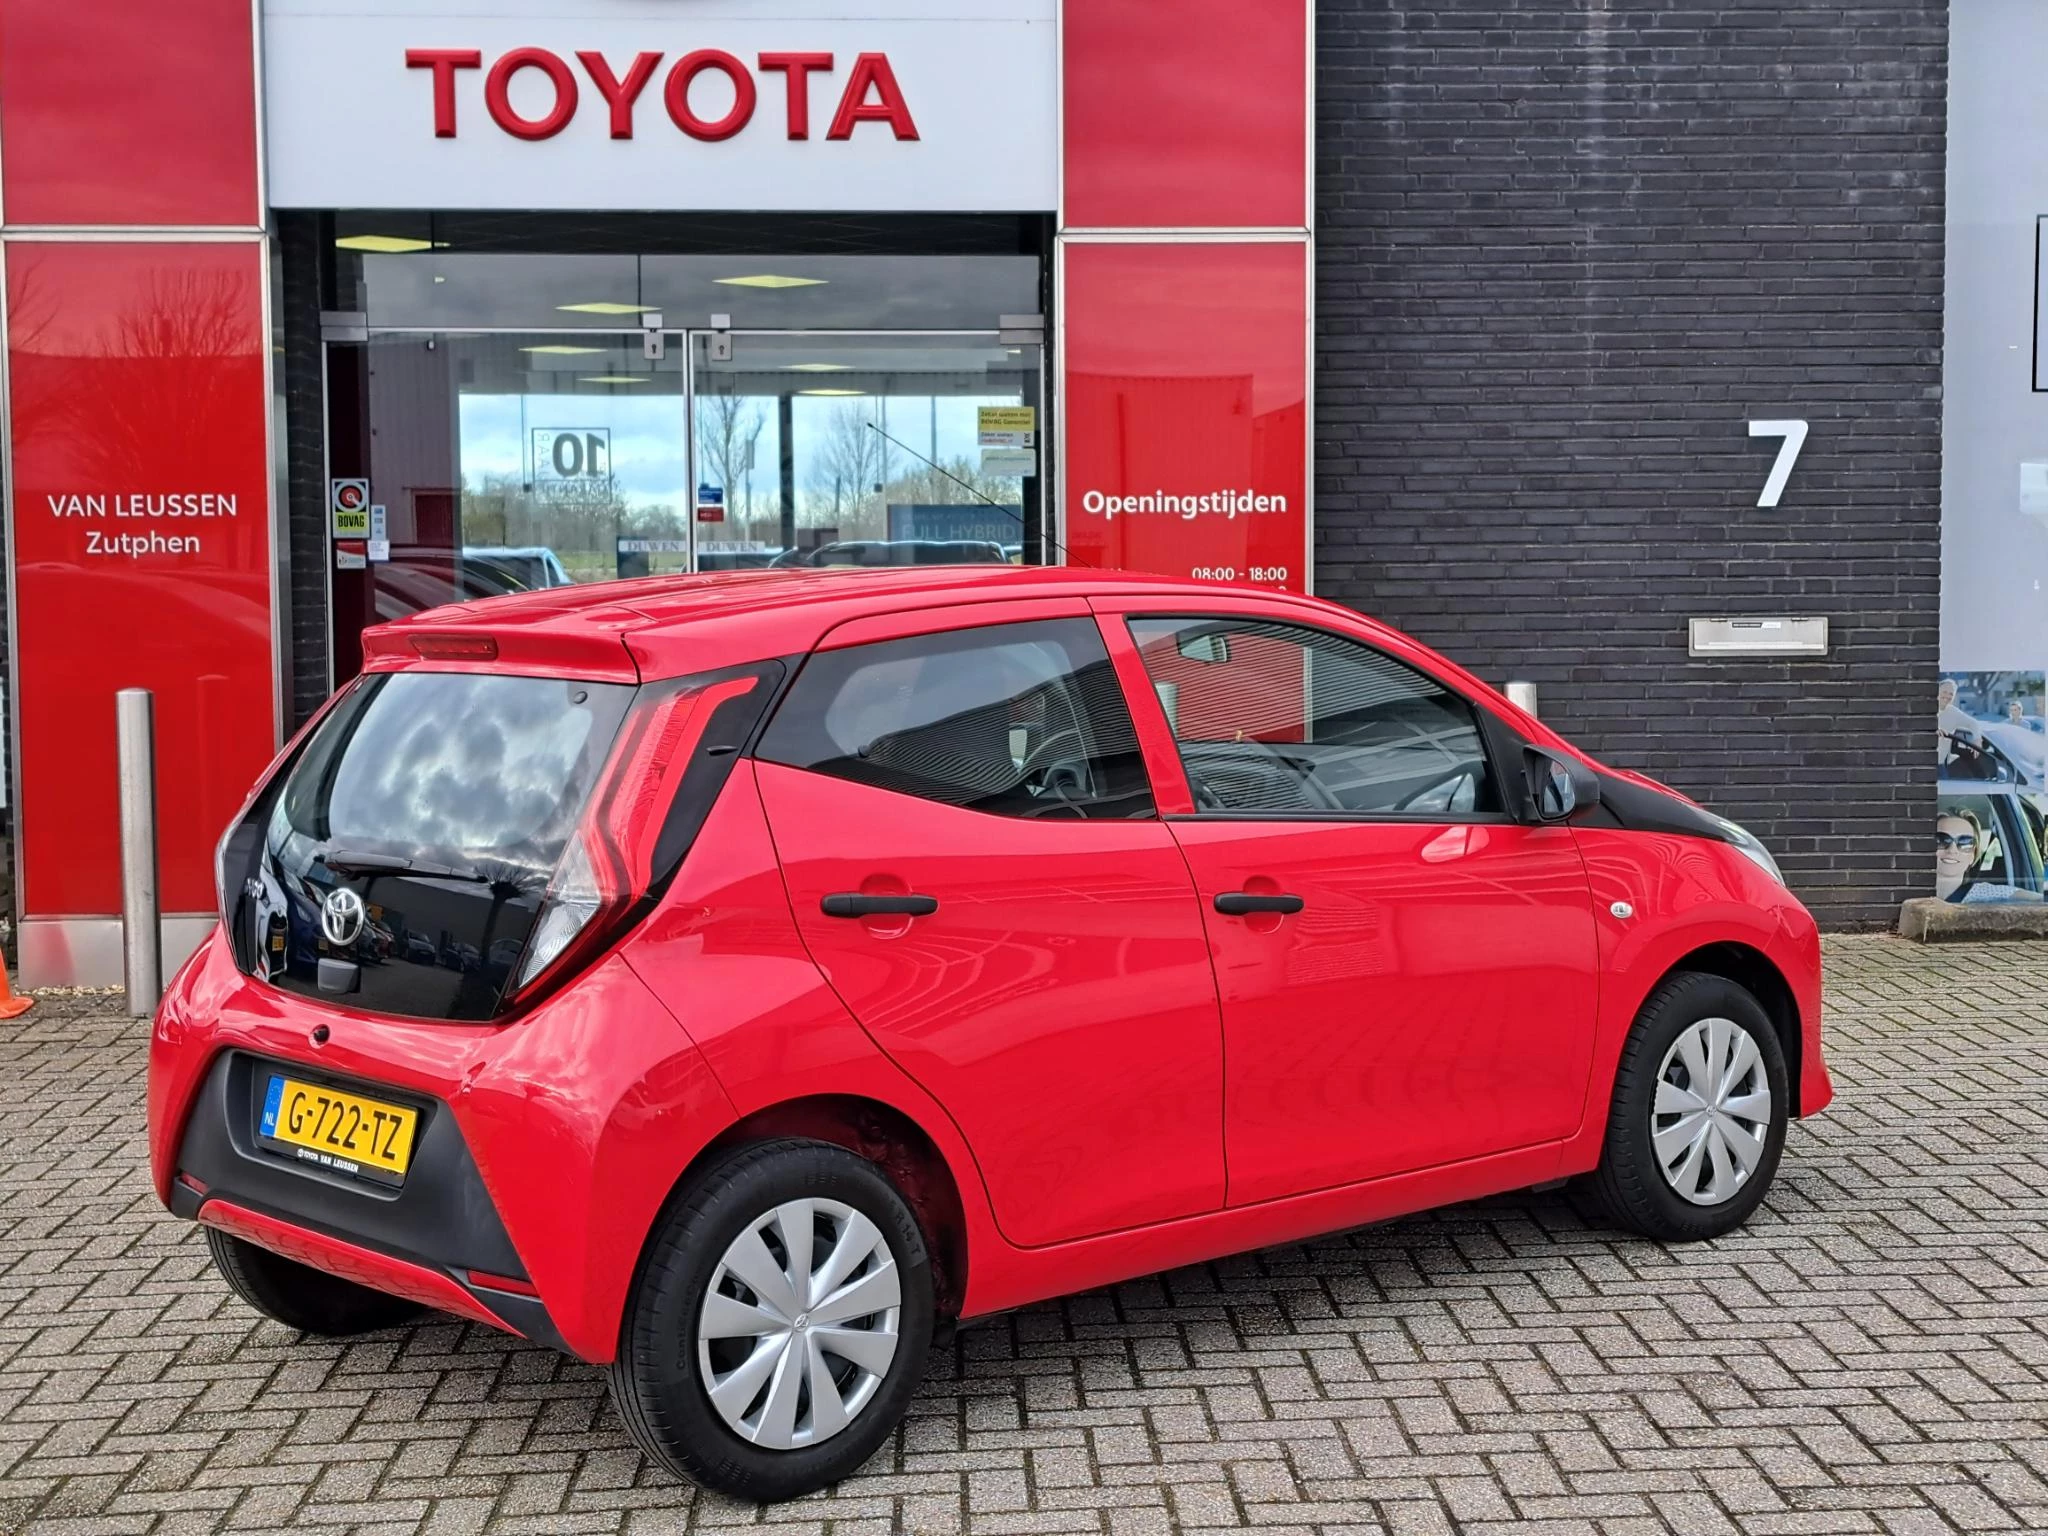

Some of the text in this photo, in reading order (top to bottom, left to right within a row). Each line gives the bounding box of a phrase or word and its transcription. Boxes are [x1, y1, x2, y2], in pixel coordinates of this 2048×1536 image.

[406, 47, 920, 141] TOYOTA
[1748, 420, 1809, 508] 7
[48, 494, 237, 517] VAN LEUSSEN
[1083, 489, 1287, 520] Openingstijden
[337, 515, 365, 528] BOVAG
[949, 524, 1016, 540] HYBRID
[86, 531, 200, 559] Zutphen
[627, 541, 680, 552] DUWEN
[706, 542, 758, 553] DUWEN
[1192, 567, 1235, 581] 08:00
[1249, 567, 1287, 581] 18:00
[264, 1111, 275, 1127] NL
[288, 1092, 403, 1160] G-722-TZ
[320, 1154, 332, 1165] VAN
[333, 1158, 359, 1173] LEUSSEN
